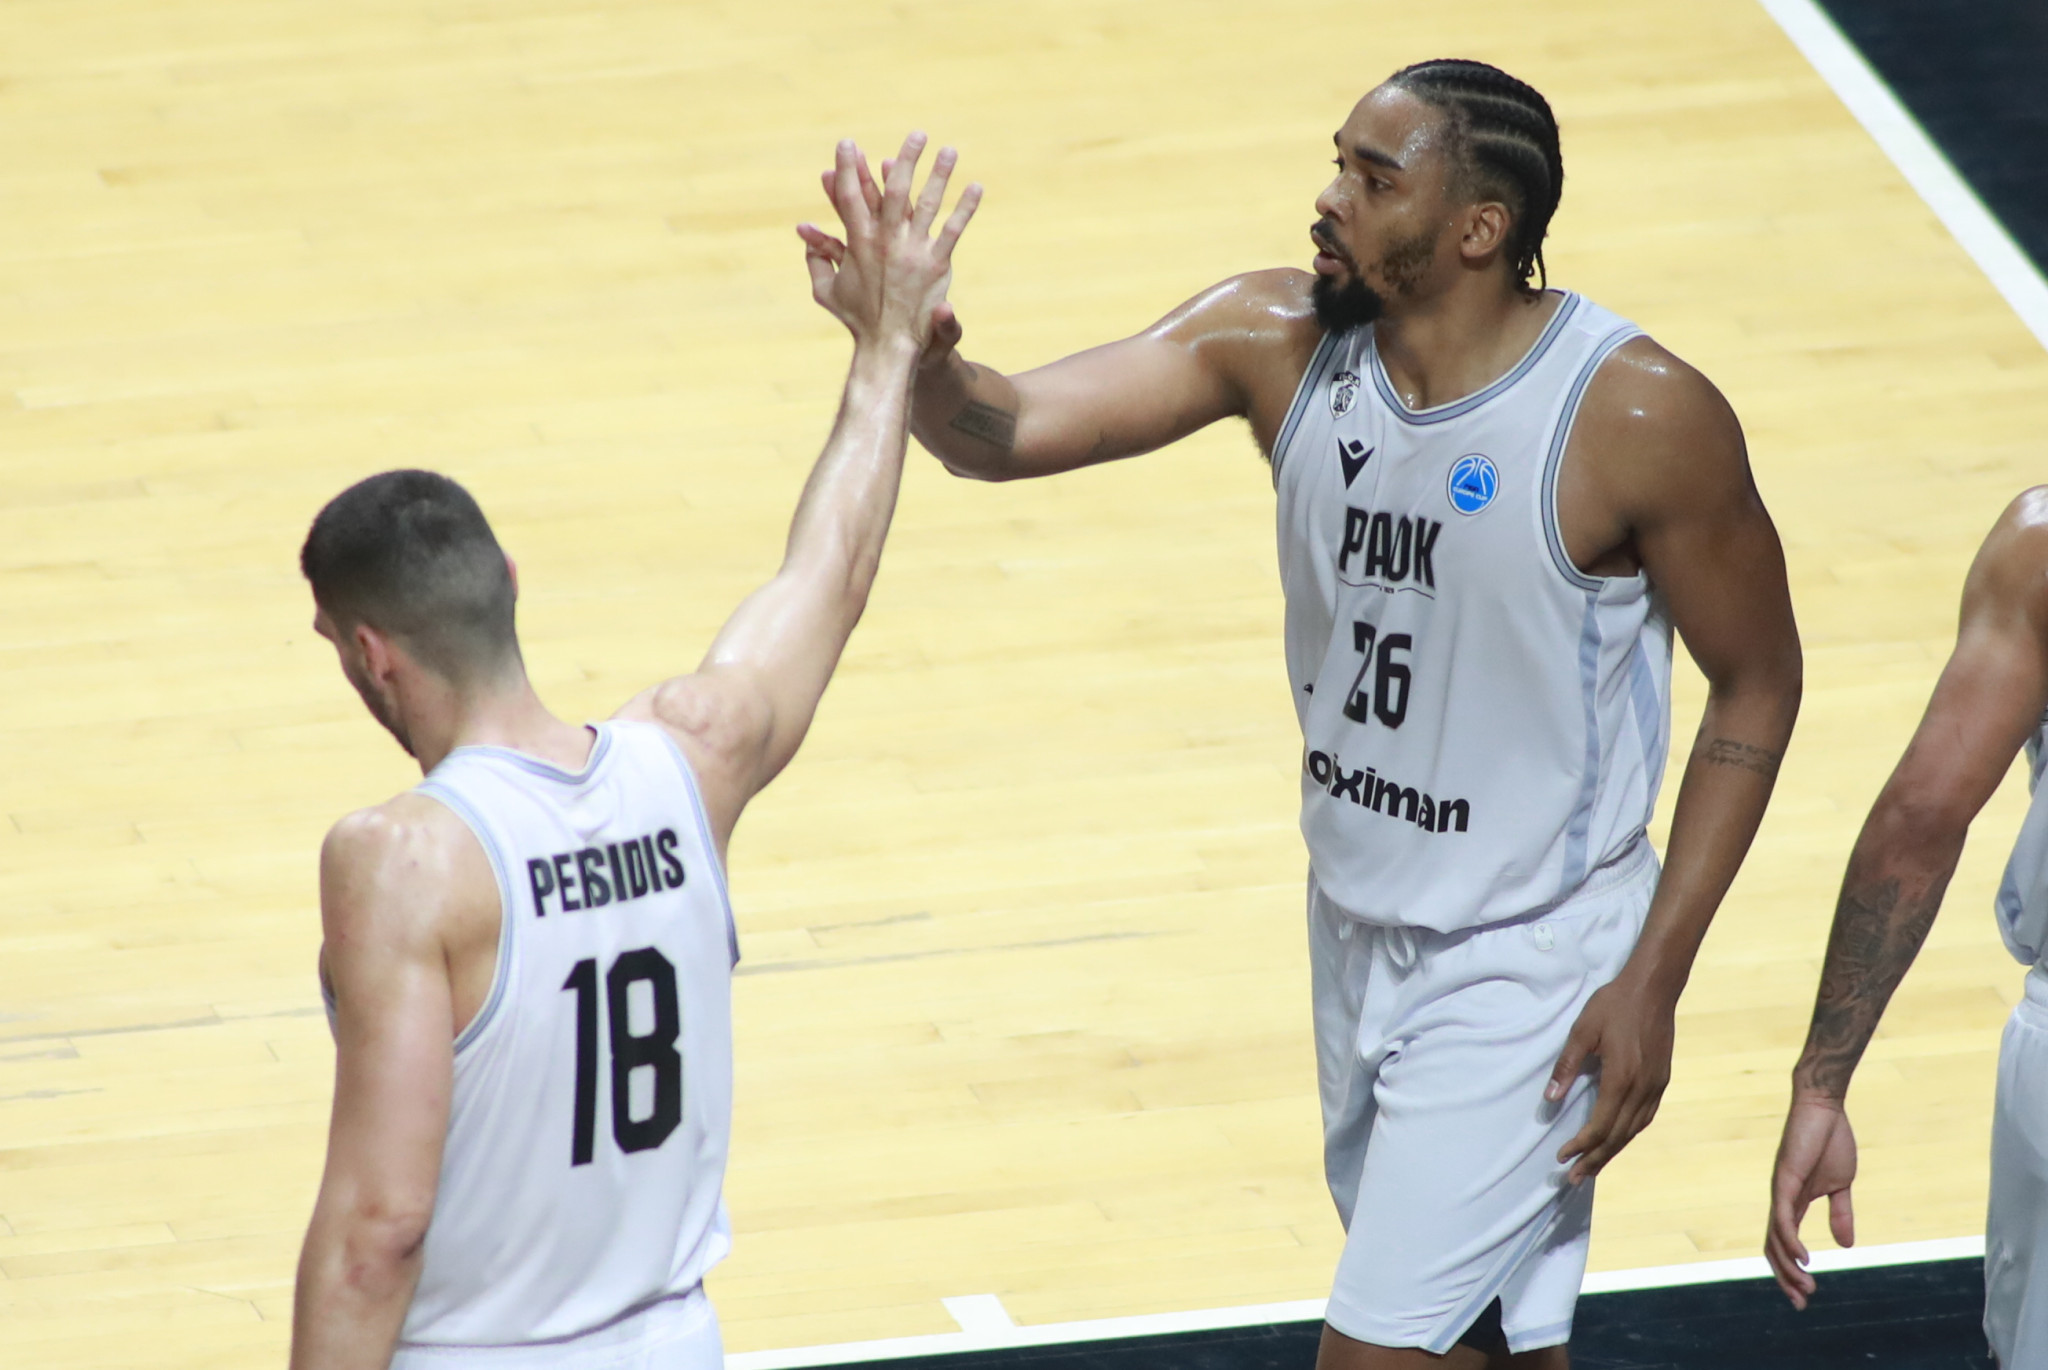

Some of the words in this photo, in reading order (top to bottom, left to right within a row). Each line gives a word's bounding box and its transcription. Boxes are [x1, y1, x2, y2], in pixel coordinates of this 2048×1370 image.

[1338, 505, 1442, 590] PAOK
[1342, 620, 1413, 731] 26
[561, 946, 682, 1168] 18
